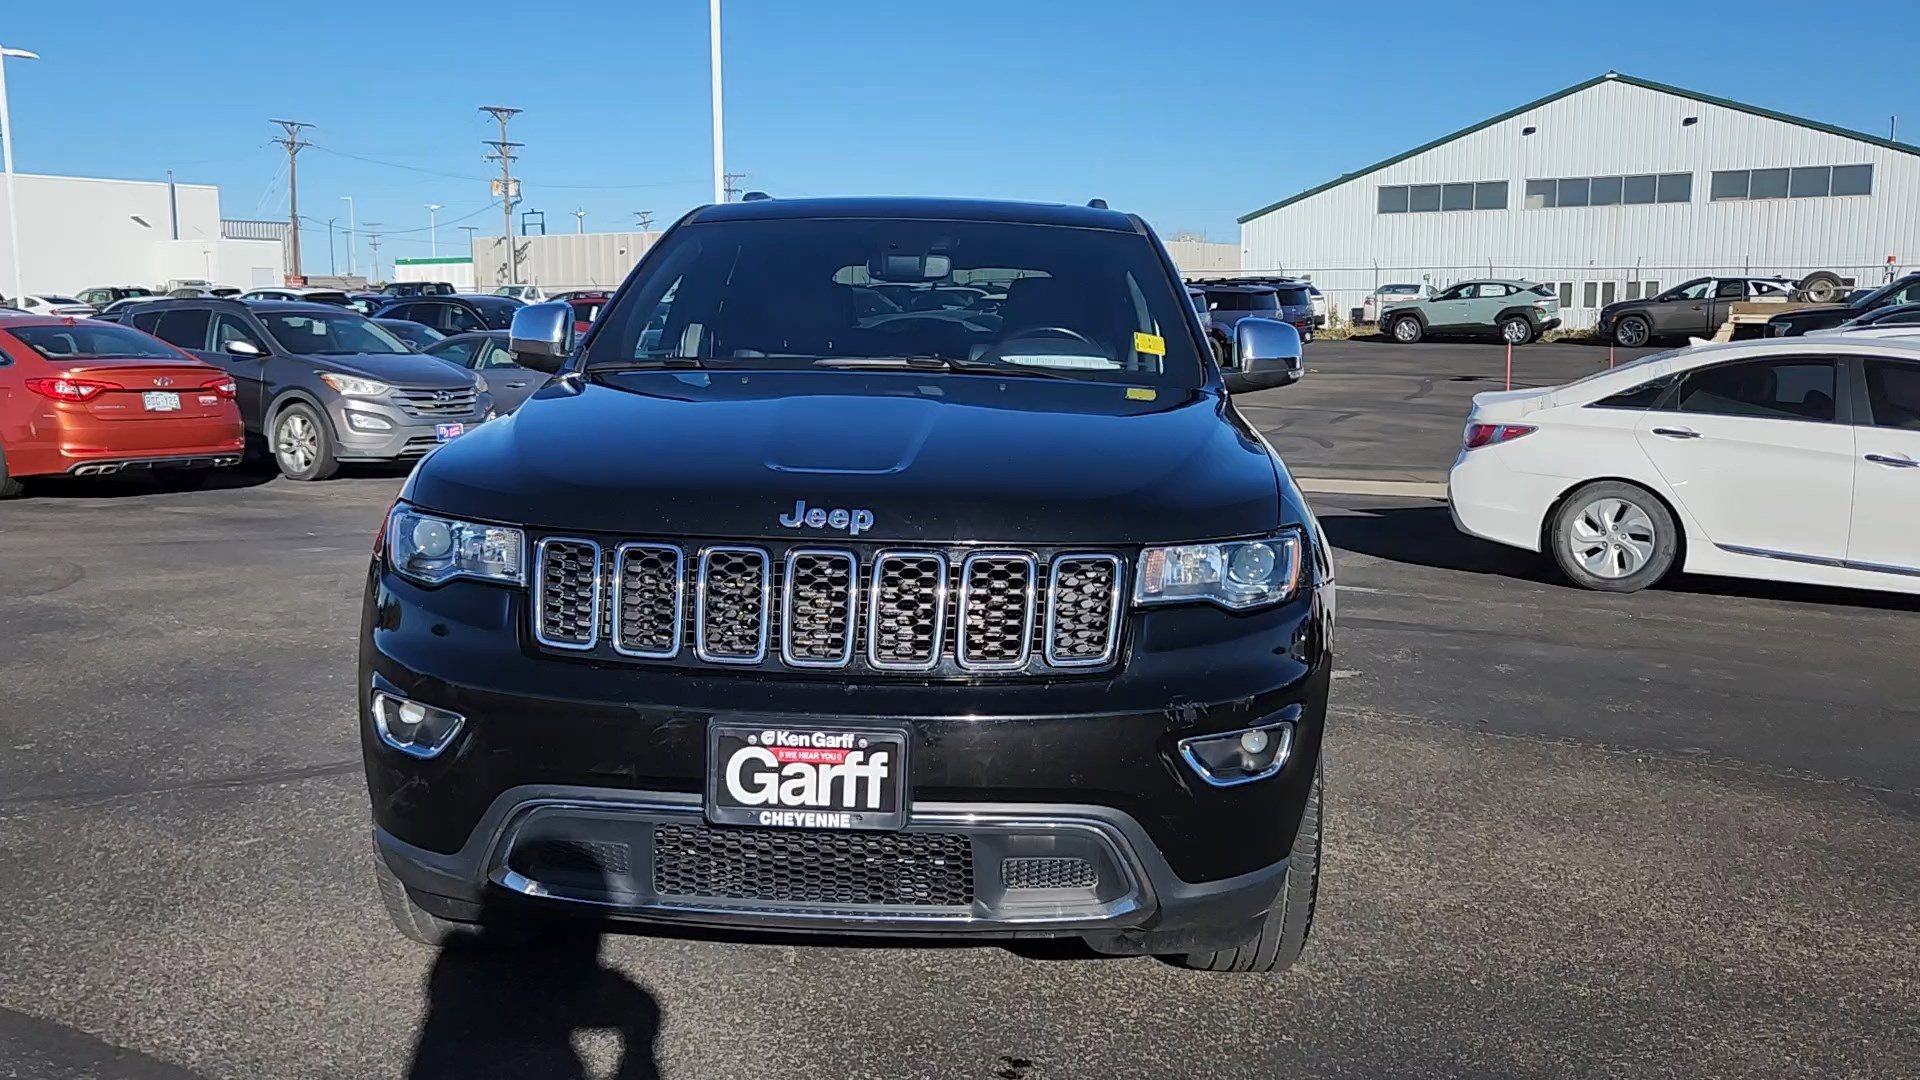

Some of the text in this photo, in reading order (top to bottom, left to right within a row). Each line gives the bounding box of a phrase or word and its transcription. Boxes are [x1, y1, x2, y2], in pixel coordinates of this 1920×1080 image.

[779, 500, 874, 535] Jeep
[777, 731, 810, 746] Ken
[811, 732, 855, 748] Garff
[785, 751, 836, 761] WE HEAR YOU
[726, 746, 888, 809] Garff
[759, 810, 851, 829] CHEYENNE
